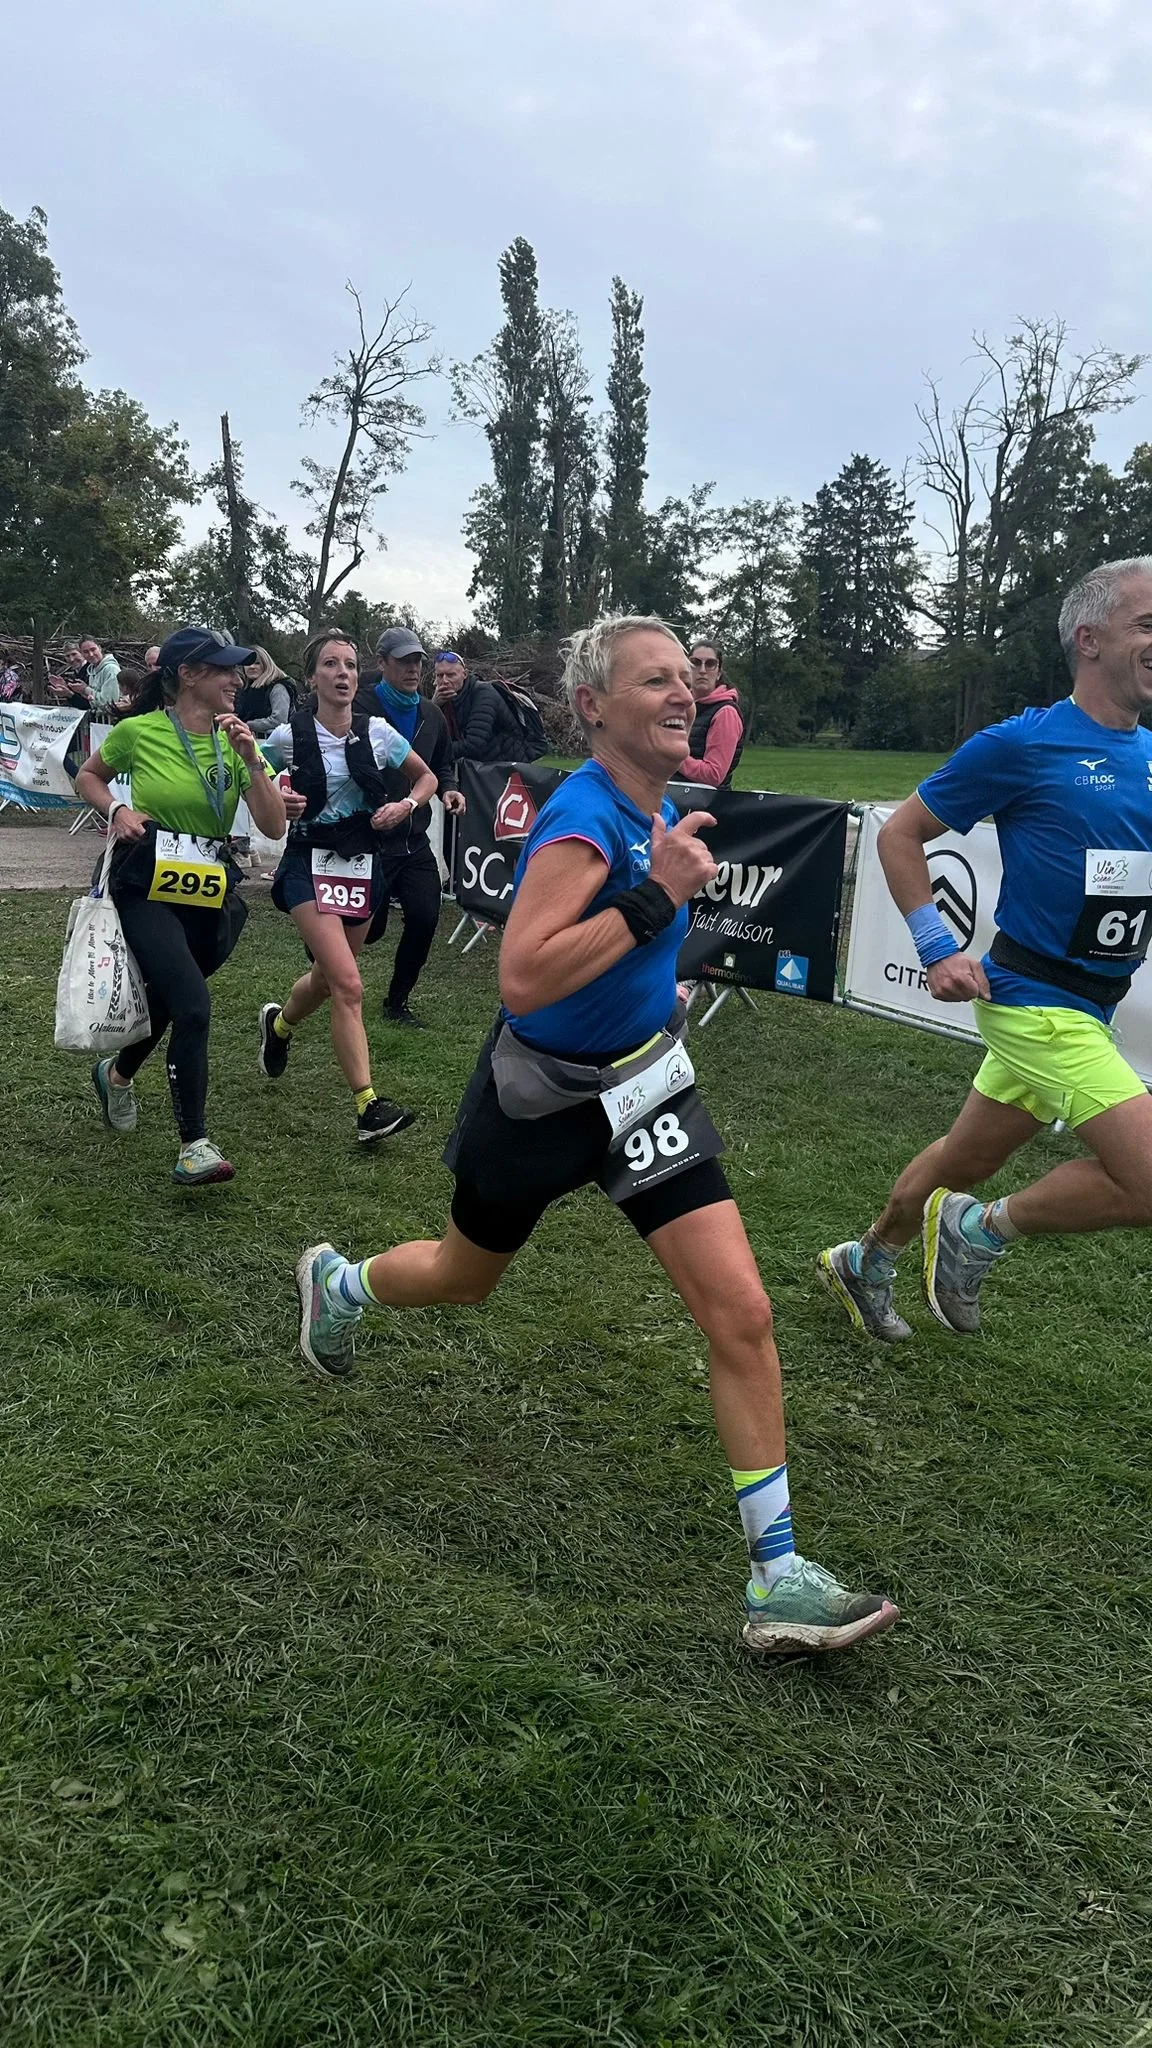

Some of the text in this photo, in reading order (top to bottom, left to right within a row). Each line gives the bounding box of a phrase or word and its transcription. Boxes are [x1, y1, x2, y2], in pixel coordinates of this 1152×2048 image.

[157, 870, 221, 898] 295
[462, 845, 514, 900] SC
[693, 860, 784, 909] eur
[1096, 859, 1116, 876] Vin
[318, 883, 366, 909] 295
[684, 904, 775, 945] fait maison
[1096, 909, 1147, 947] 61
[884, 962, 930, 992] CITR
[624, 1112, 690, 1171] 98
